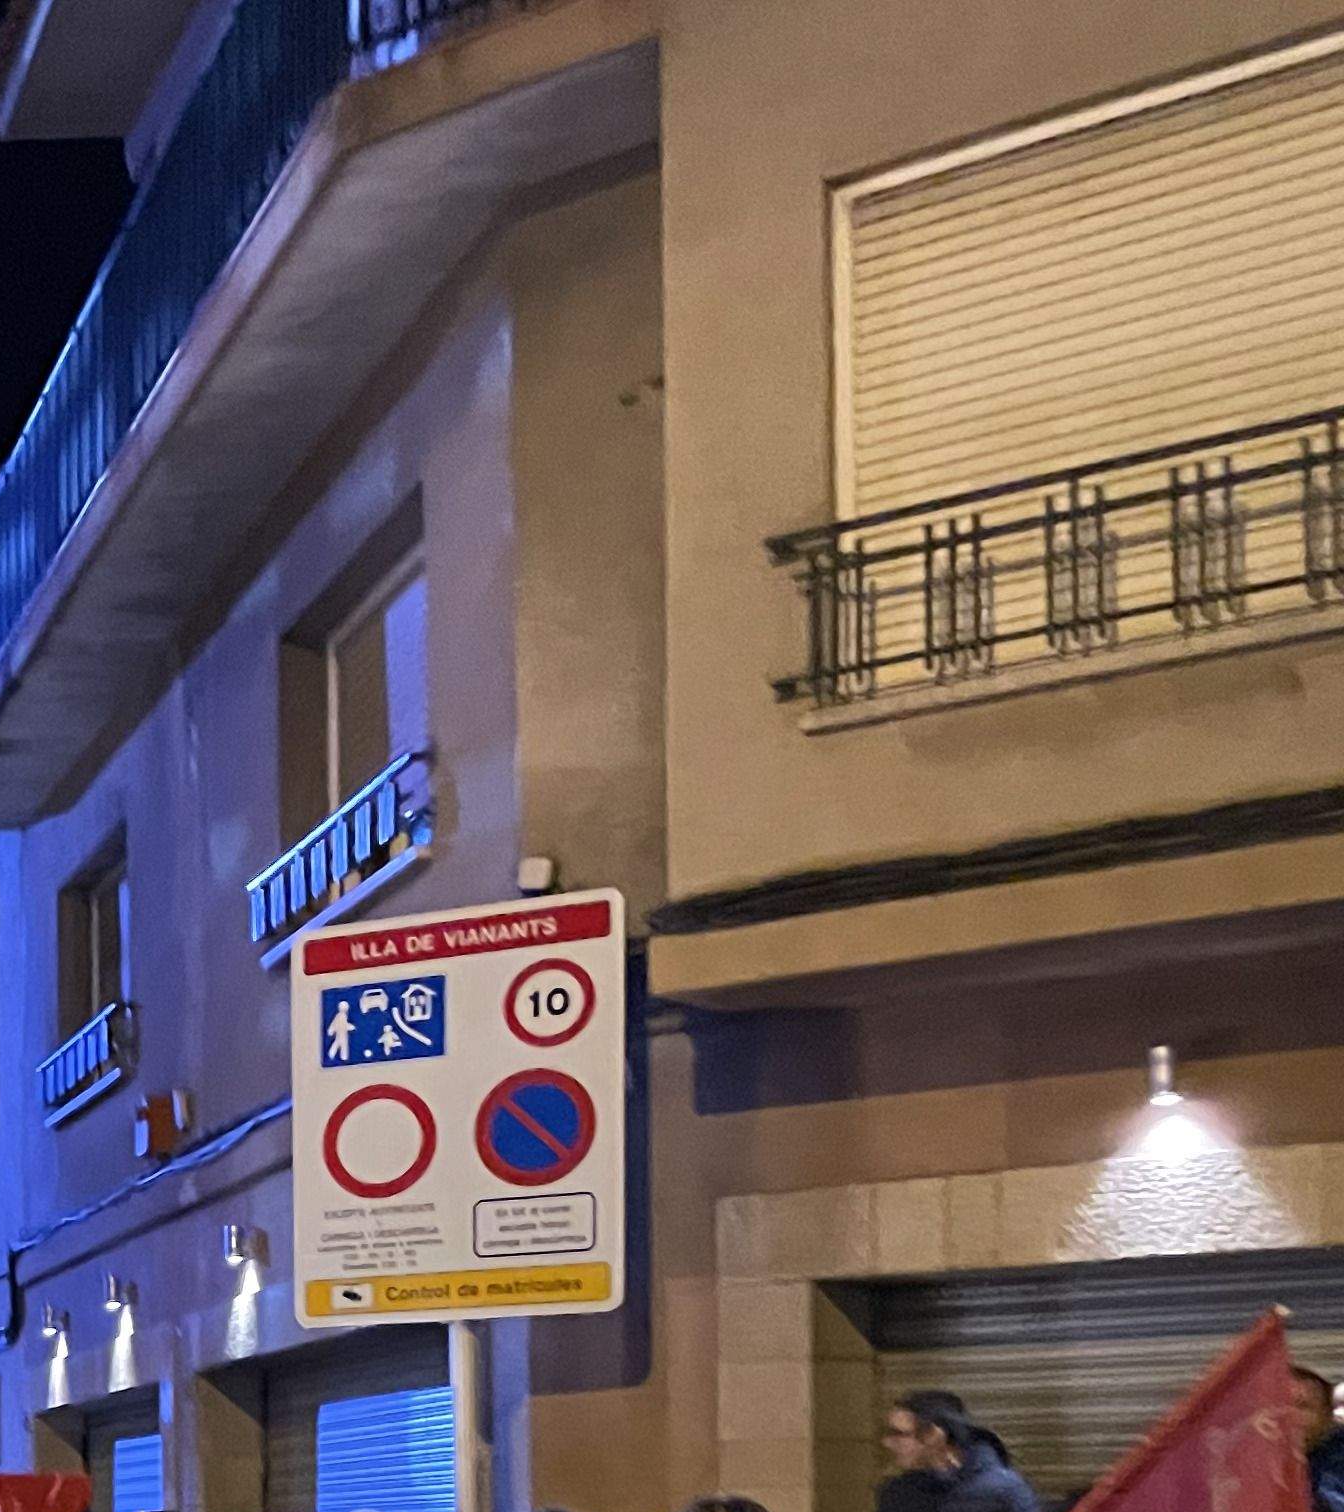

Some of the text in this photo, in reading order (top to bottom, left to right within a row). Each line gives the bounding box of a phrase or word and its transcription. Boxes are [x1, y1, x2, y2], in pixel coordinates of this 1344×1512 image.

[350, 916, 558, 961] ILLA DE VIANANTS
[529, 987, 570, 1017] 10
[385, 1283, 450, 1301] Control
[457, 1283, 479, 1297] de
